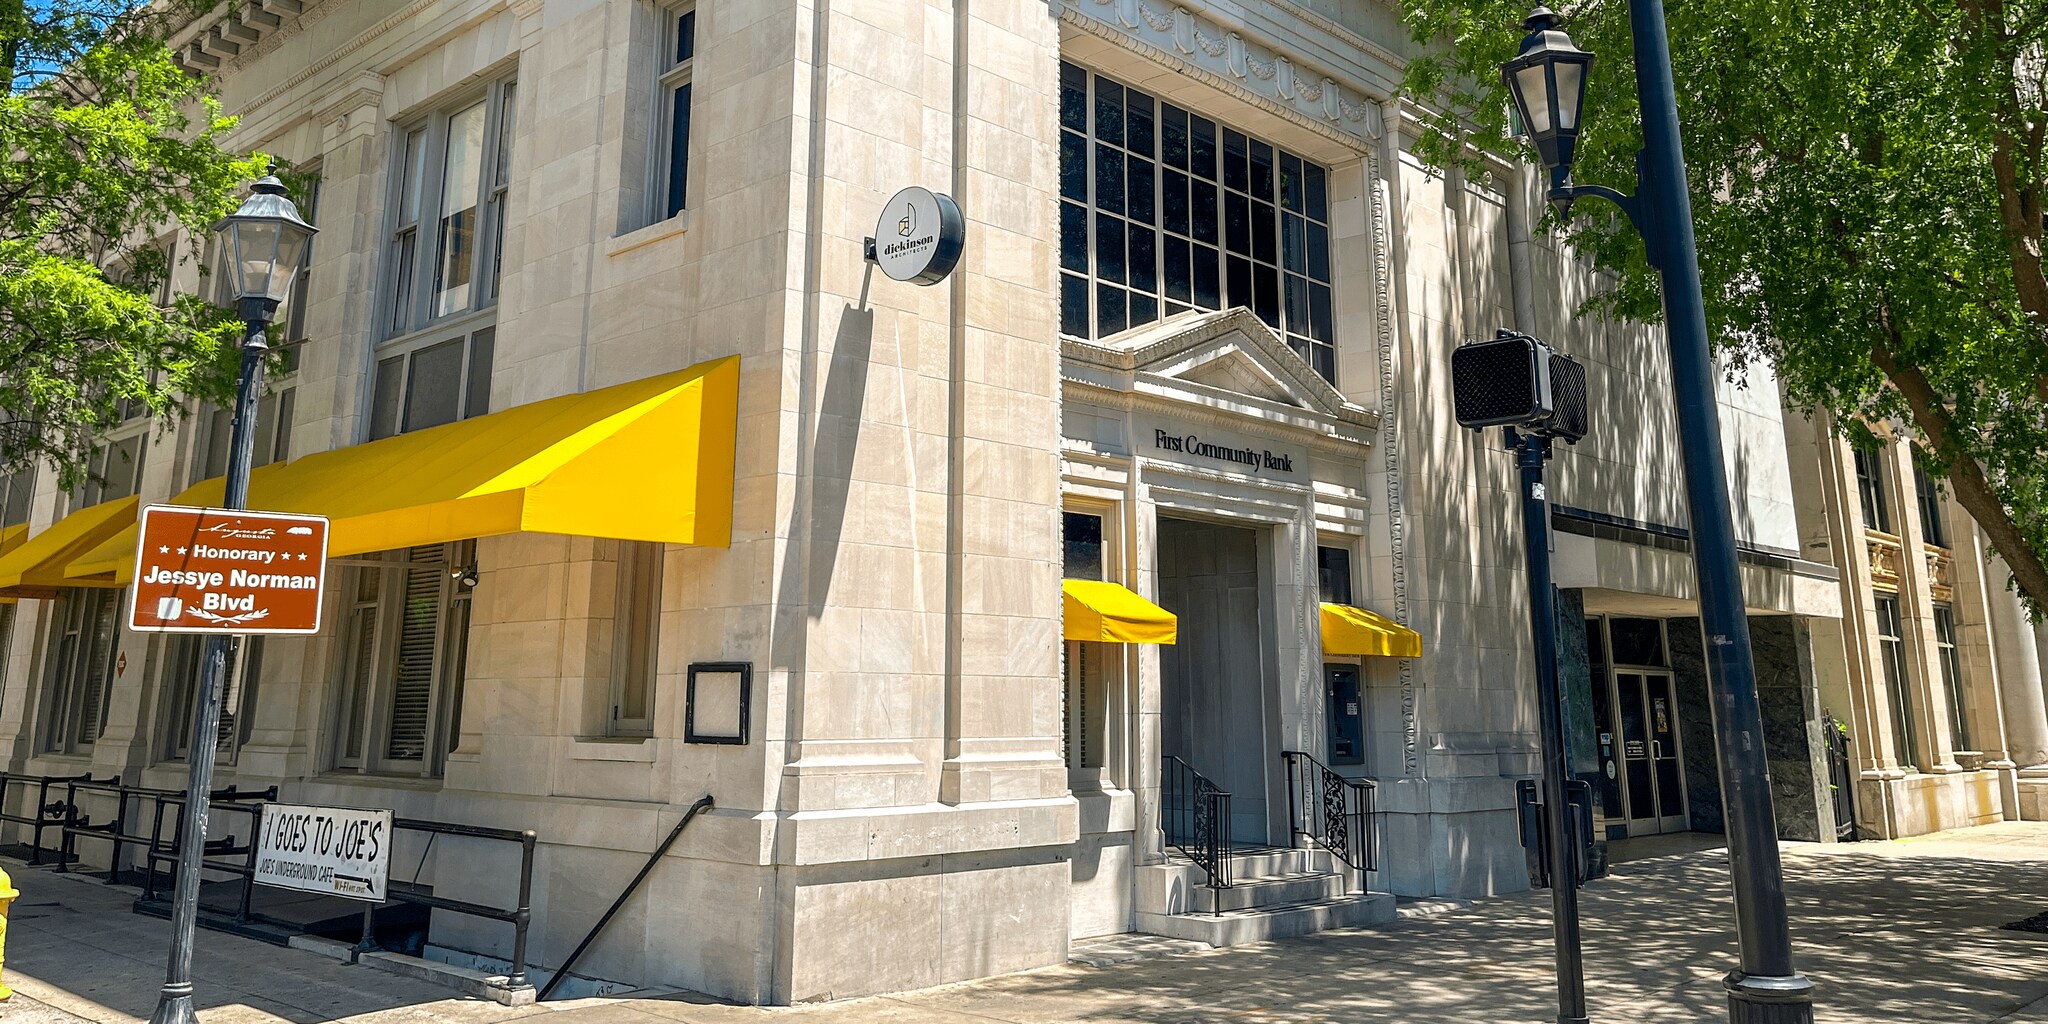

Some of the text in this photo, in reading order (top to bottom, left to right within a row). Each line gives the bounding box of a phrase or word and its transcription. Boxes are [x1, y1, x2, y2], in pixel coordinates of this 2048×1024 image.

[884, 235, 933, 255] dickinson
[891, 246, 927, 259] ARCHITECTS
[1155, 429, 1293, 472] First Community Bank
[193, 544, 276, 564] Honorary
[143, 565, 317, 590] Jessye Norman
[203, 592, 255, 611] Blvd
[264, 813, 382, 862] I GOES TO JOE'S
[275, 860, 318, 881] UNDERGROUND
[318, 865, 334, 883] CAFE
